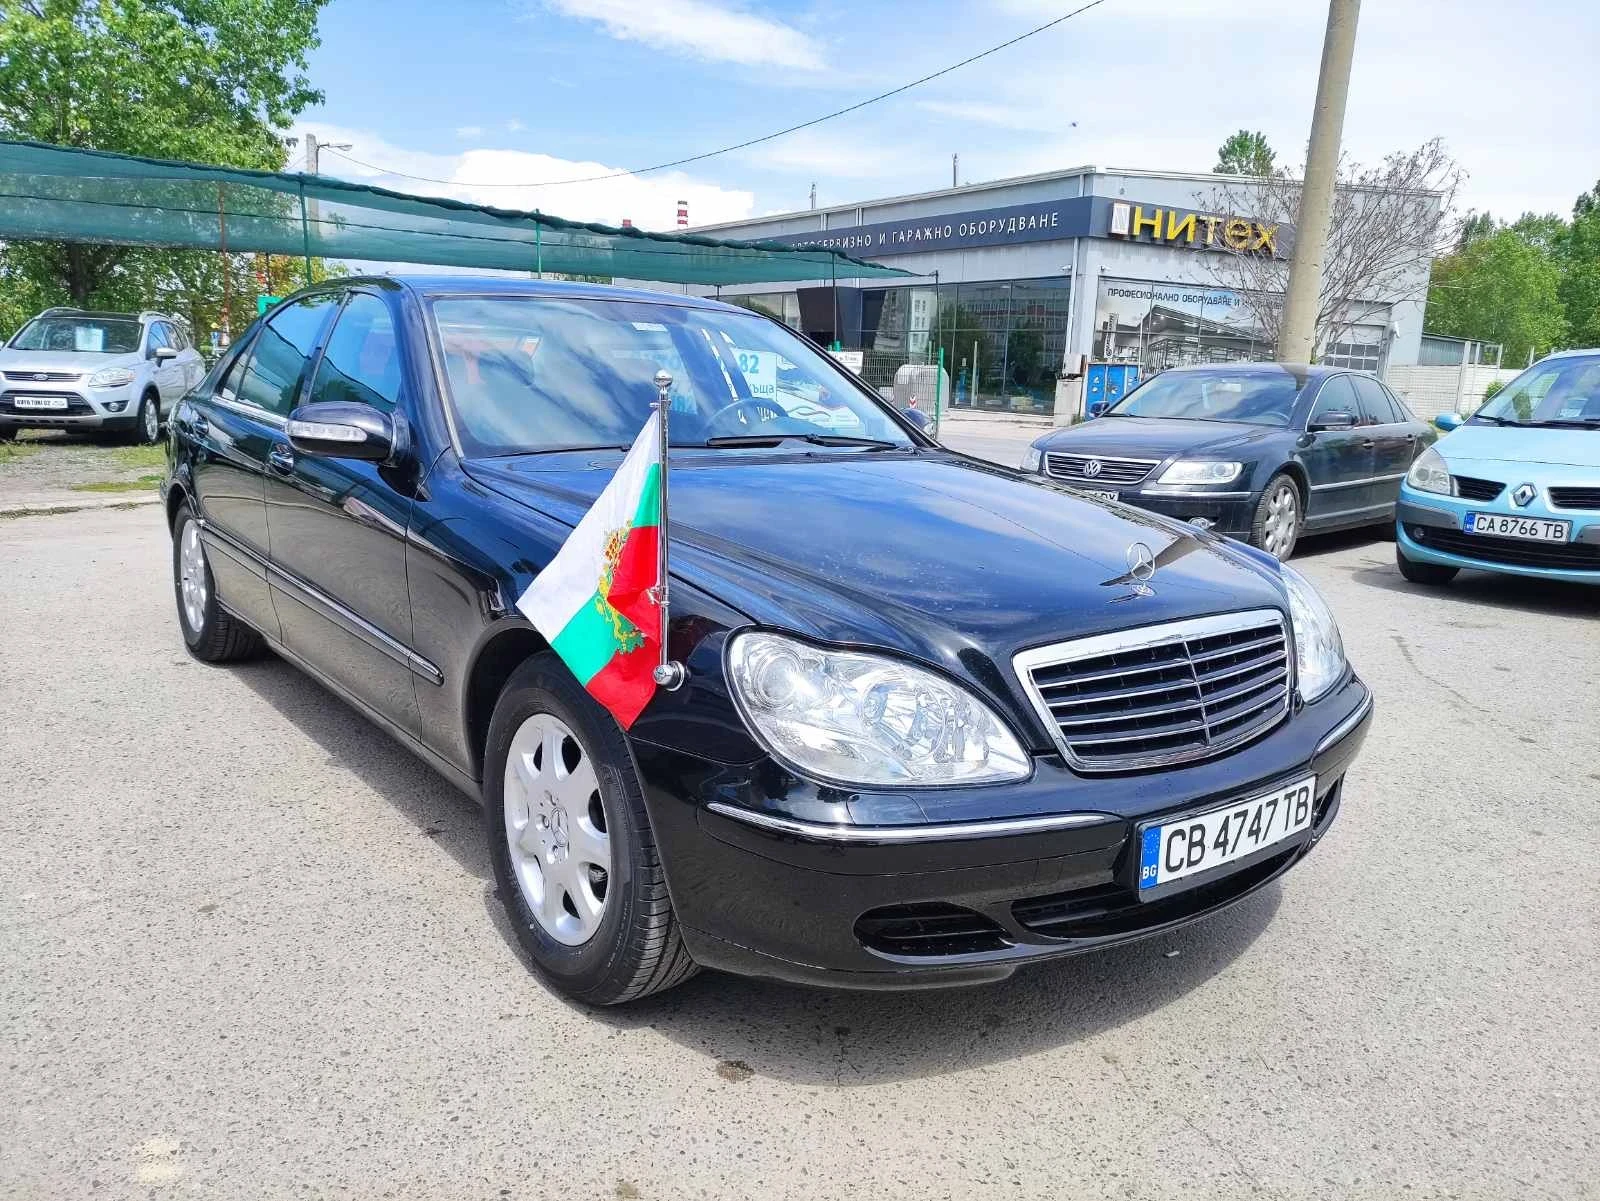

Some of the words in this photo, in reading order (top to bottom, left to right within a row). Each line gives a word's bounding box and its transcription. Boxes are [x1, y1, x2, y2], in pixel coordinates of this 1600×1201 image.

[879, 233, 887, 246] И
[892, 224, 952, 244] ГАРАЖНО
[959, 211, 1059, 236] ОБОРУДВАНЕ
[1107, 288, 1179, 302] ПРОФЕСИОНАЛНО
[1182, 294, 1232, 306] ОБОРУДВАНЕ
[1476, 516, 1495, 532] CA
[1500, 519, 1538, 536] 8766
[1543, 523, 1564, 539] TB
[1165, 823, 1206, 873] CB
[1213, 797, 1279, 857] 4747
[1283, 785, 1310, 831] TB
[1142, 865, 1157, 880] BG
